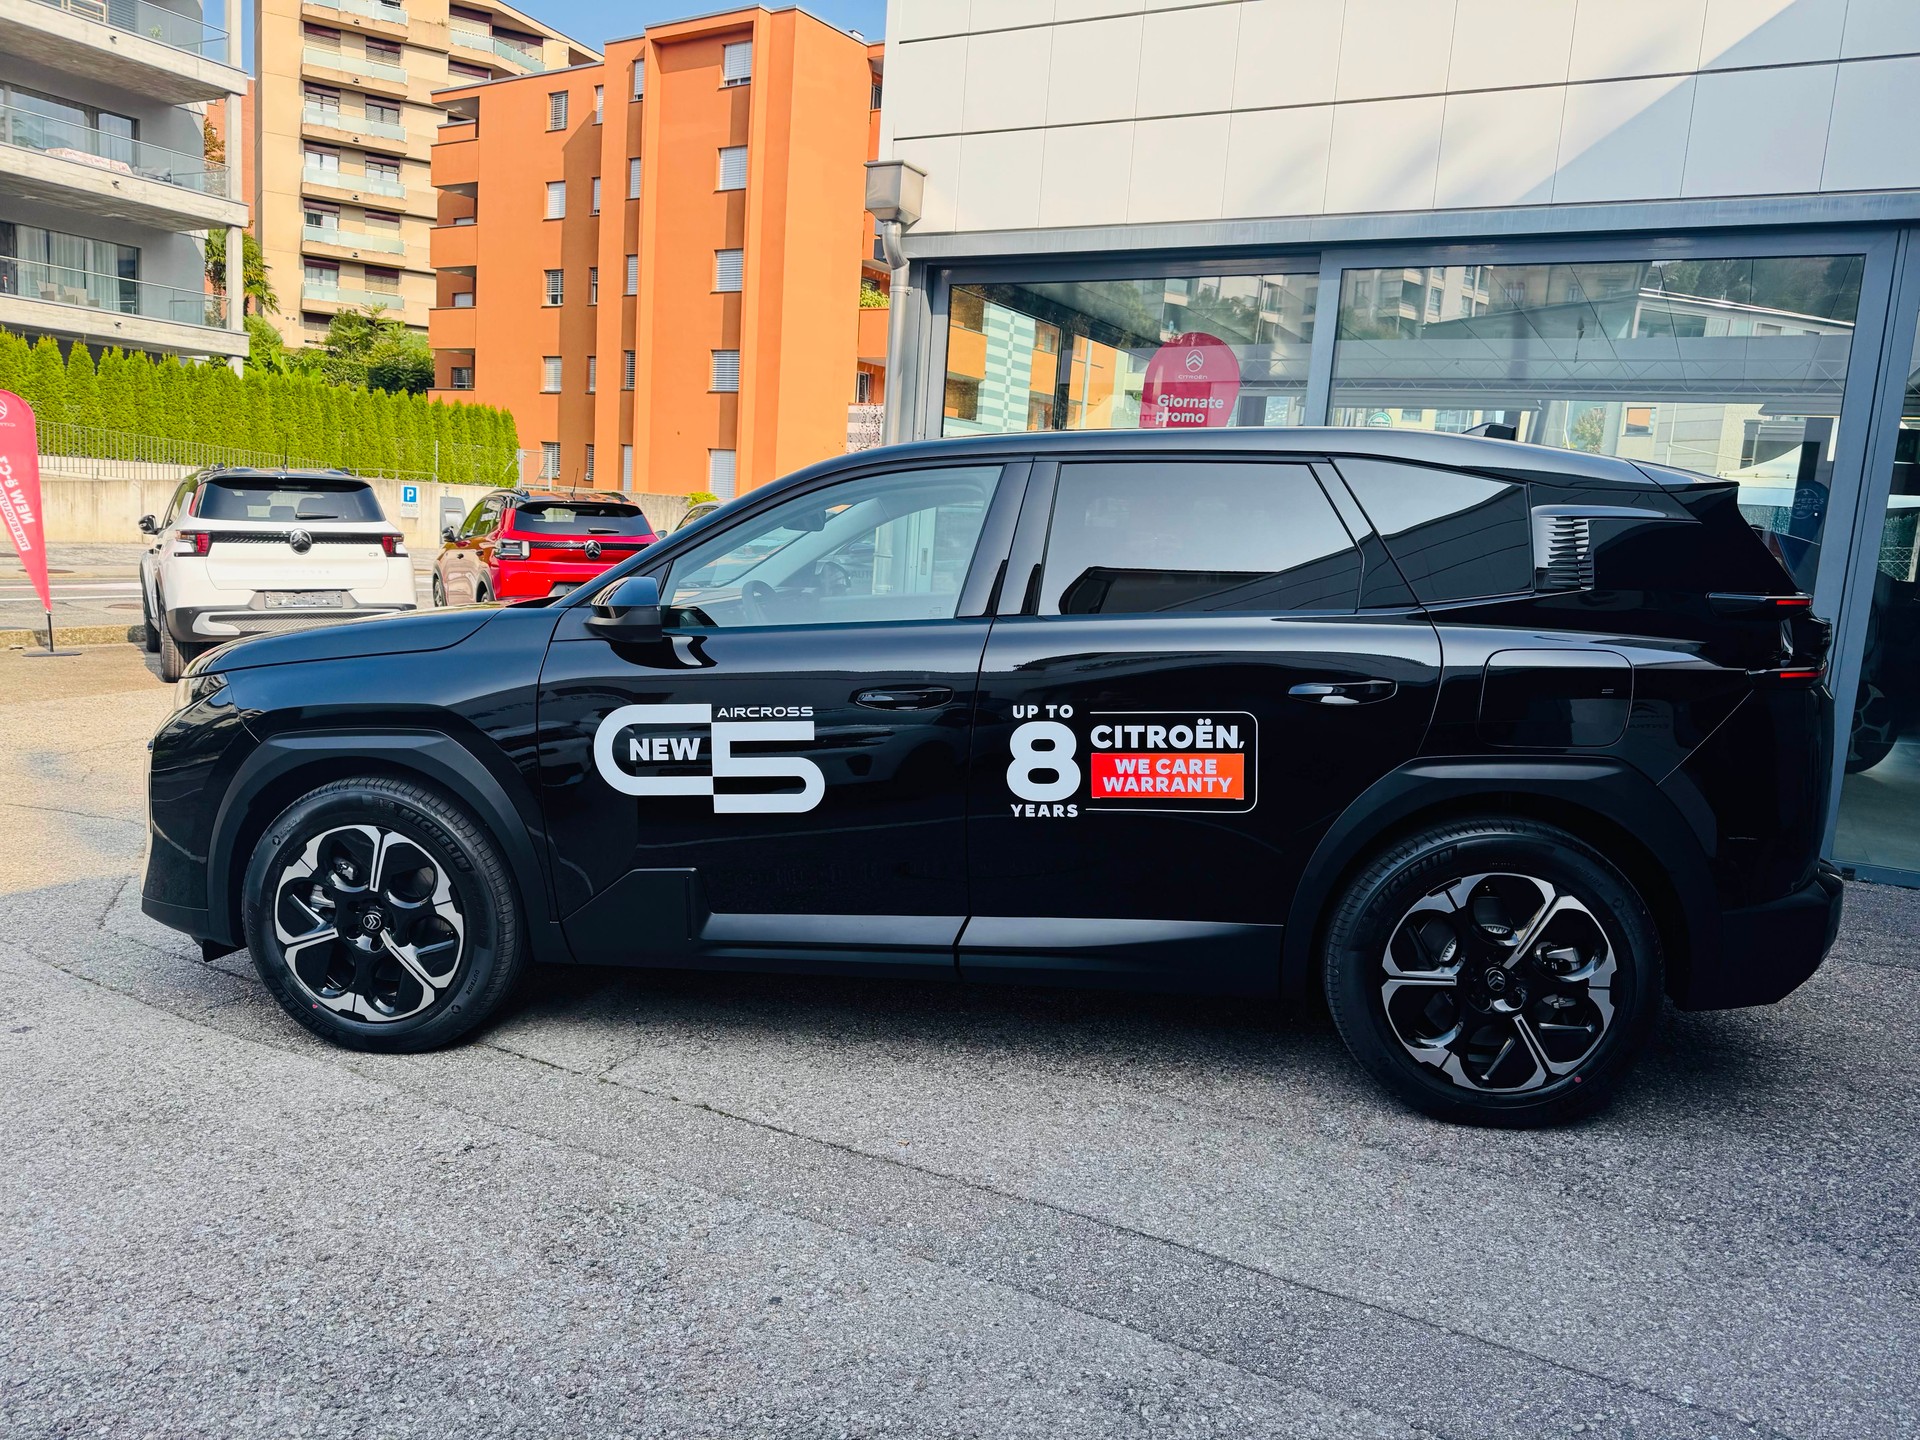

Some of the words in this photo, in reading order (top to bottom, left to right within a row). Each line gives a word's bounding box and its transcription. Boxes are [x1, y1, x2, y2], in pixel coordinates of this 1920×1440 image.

[1157, 394, 1224, 409] Giornate
[1155, 410, 1205, 425] promo
[407, 489, 415, 501] P
[716, 706, 814, 717] AIRCROSS
[1012, 705, 1039, 718] UP
[1045, 704, 1074, 718] TO
[629, 737, 701, 761] NEW
[1006, 721, 1081, 802] 8
[1114, 759, 1151, 774] WE
[1155, 759, 1217, 775] CARE
[1103, 776, 1233, 793] WARRANTY
[1010, 804, 1079, 817] YEARS
[400, 808, 470, 870] MICHELIN
